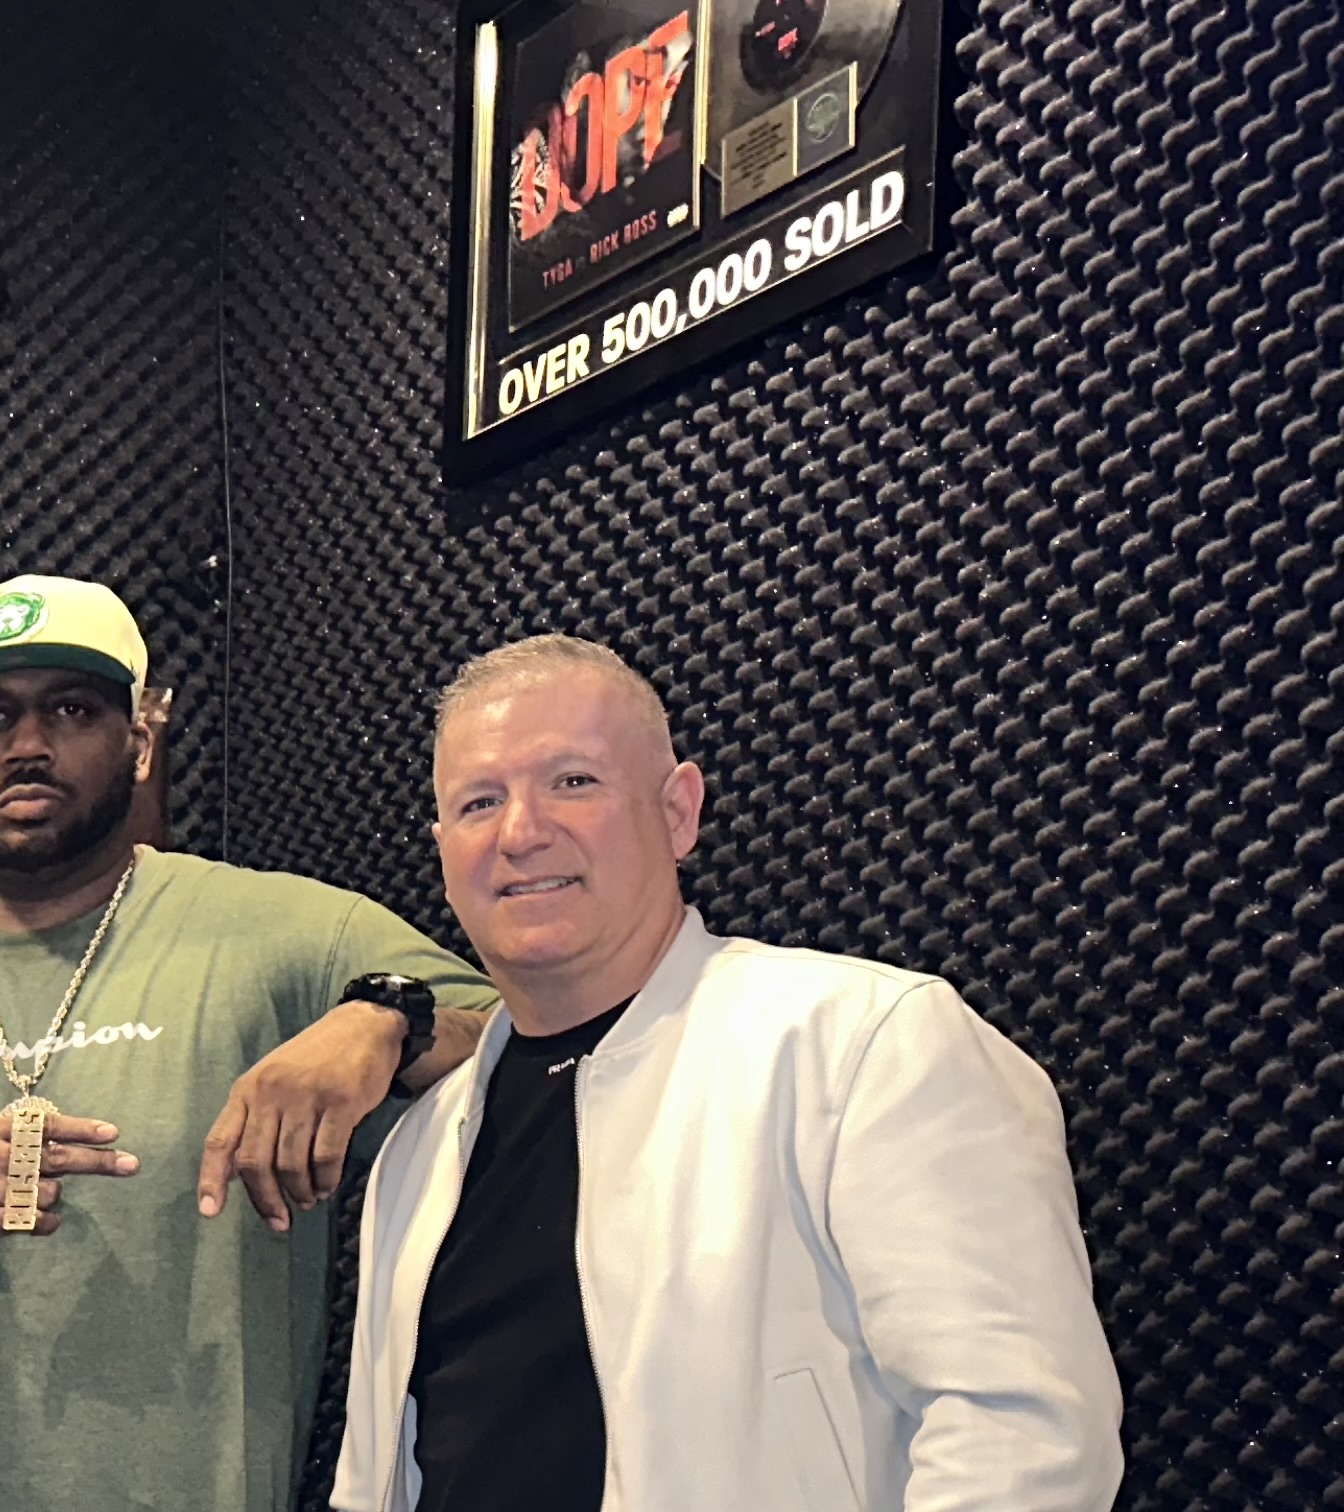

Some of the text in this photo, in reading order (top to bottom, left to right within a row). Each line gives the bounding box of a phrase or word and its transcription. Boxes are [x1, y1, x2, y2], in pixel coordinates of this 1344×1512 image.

[498, 170, 905, 416] OVER 500,000 SOLD
[542, 257, 573, 289] TYGA
[590, 230, 619, 263] RICK
[624, 209, 657, 244] ROSS
